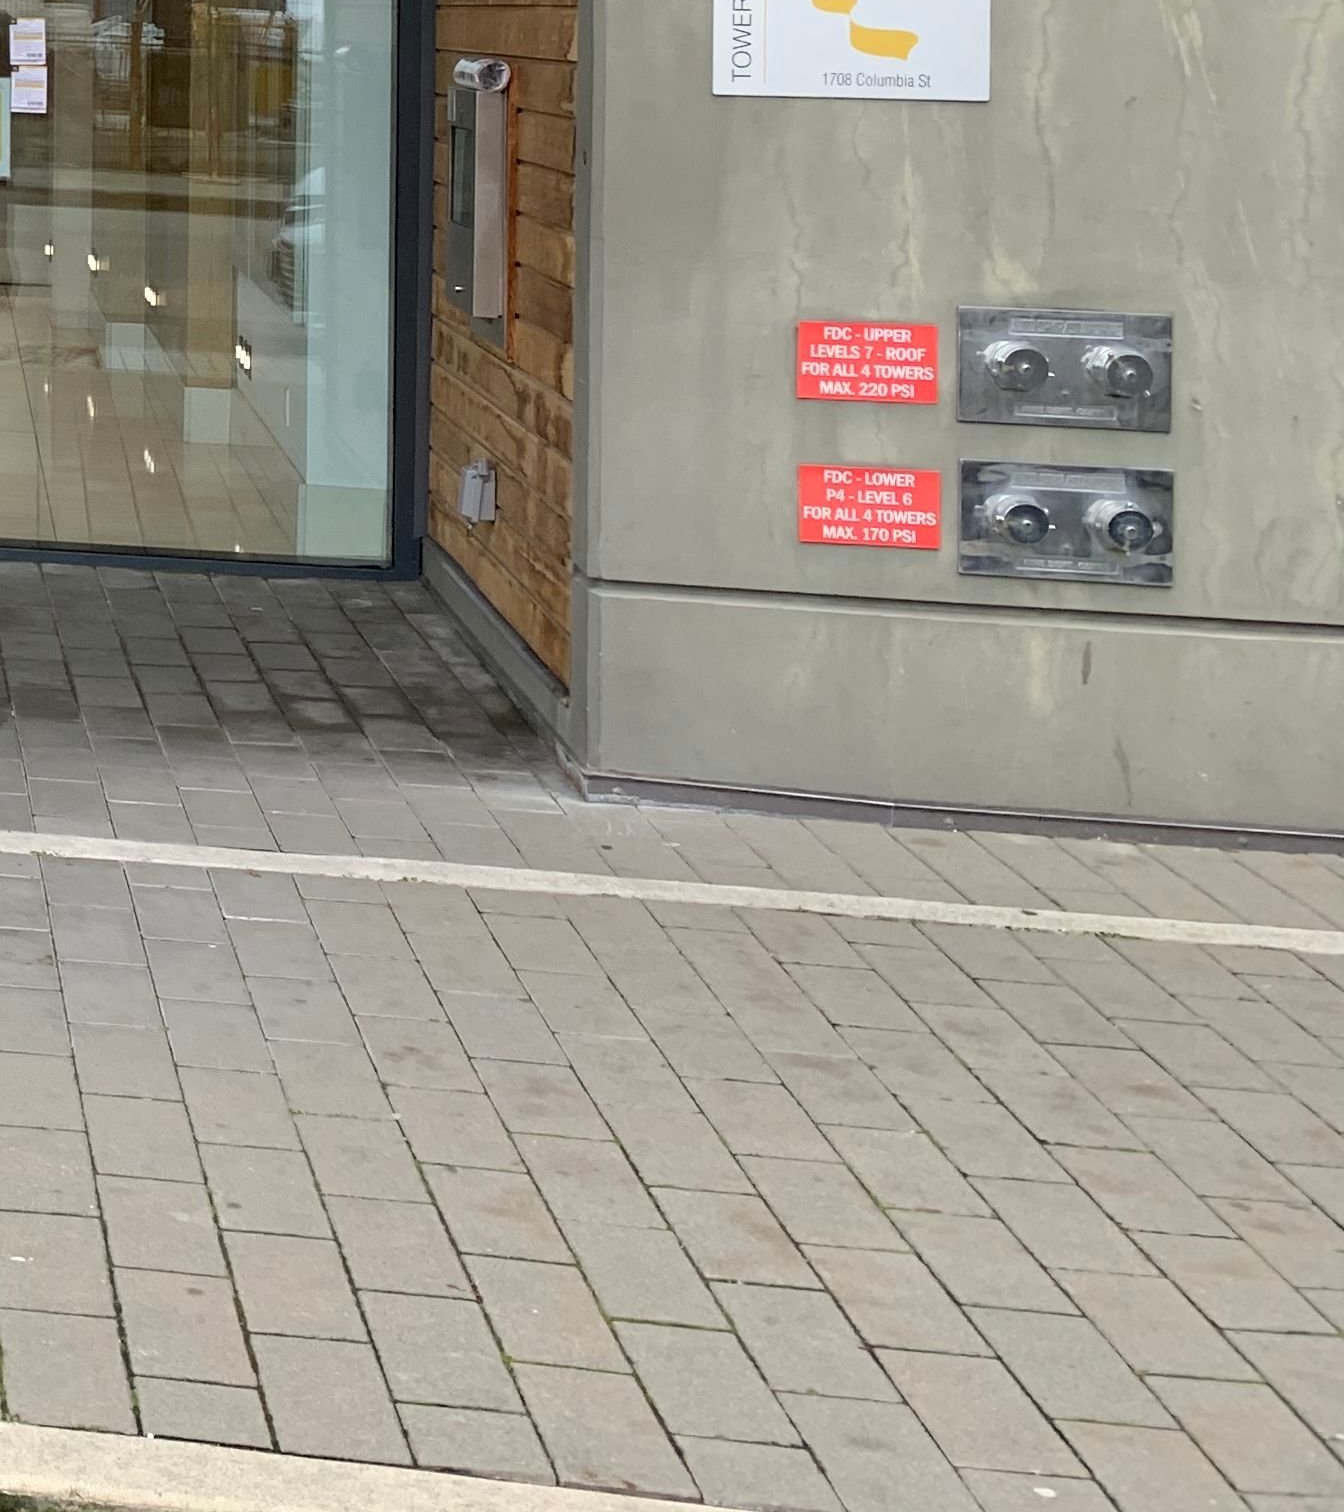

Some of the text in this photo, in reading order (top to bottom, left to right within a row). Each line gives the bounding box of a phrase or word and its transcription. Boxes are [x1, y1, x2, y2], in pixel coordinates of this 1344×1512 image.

[822, 72, 931, 88] 1708 Columbia St
[823, 326, 852, 340] FDC
[864, 328, 912, 343] UPPER
[810, 344, 861, 359] LEVELS
[864, 346, 874, 360] 7
[886, 347, 927, 362] ROOF
[802, 362, 935, 381] FOR ALL 4 TOWERS
[819, 380, 915, 399] MAX. 220 PSI
[823, 469, 853, 485] FDC
[865, 472, 915, 488] LOWER
[826, 488, 845, 502] P4
[857, 490, 899, 506] LEVEL
[902, 492, 913, 506] 6
[803, 506, 937, 526] FOR ALL 4 TOWERS
[822, 525, 916, 544] MAX. 170 PSI
